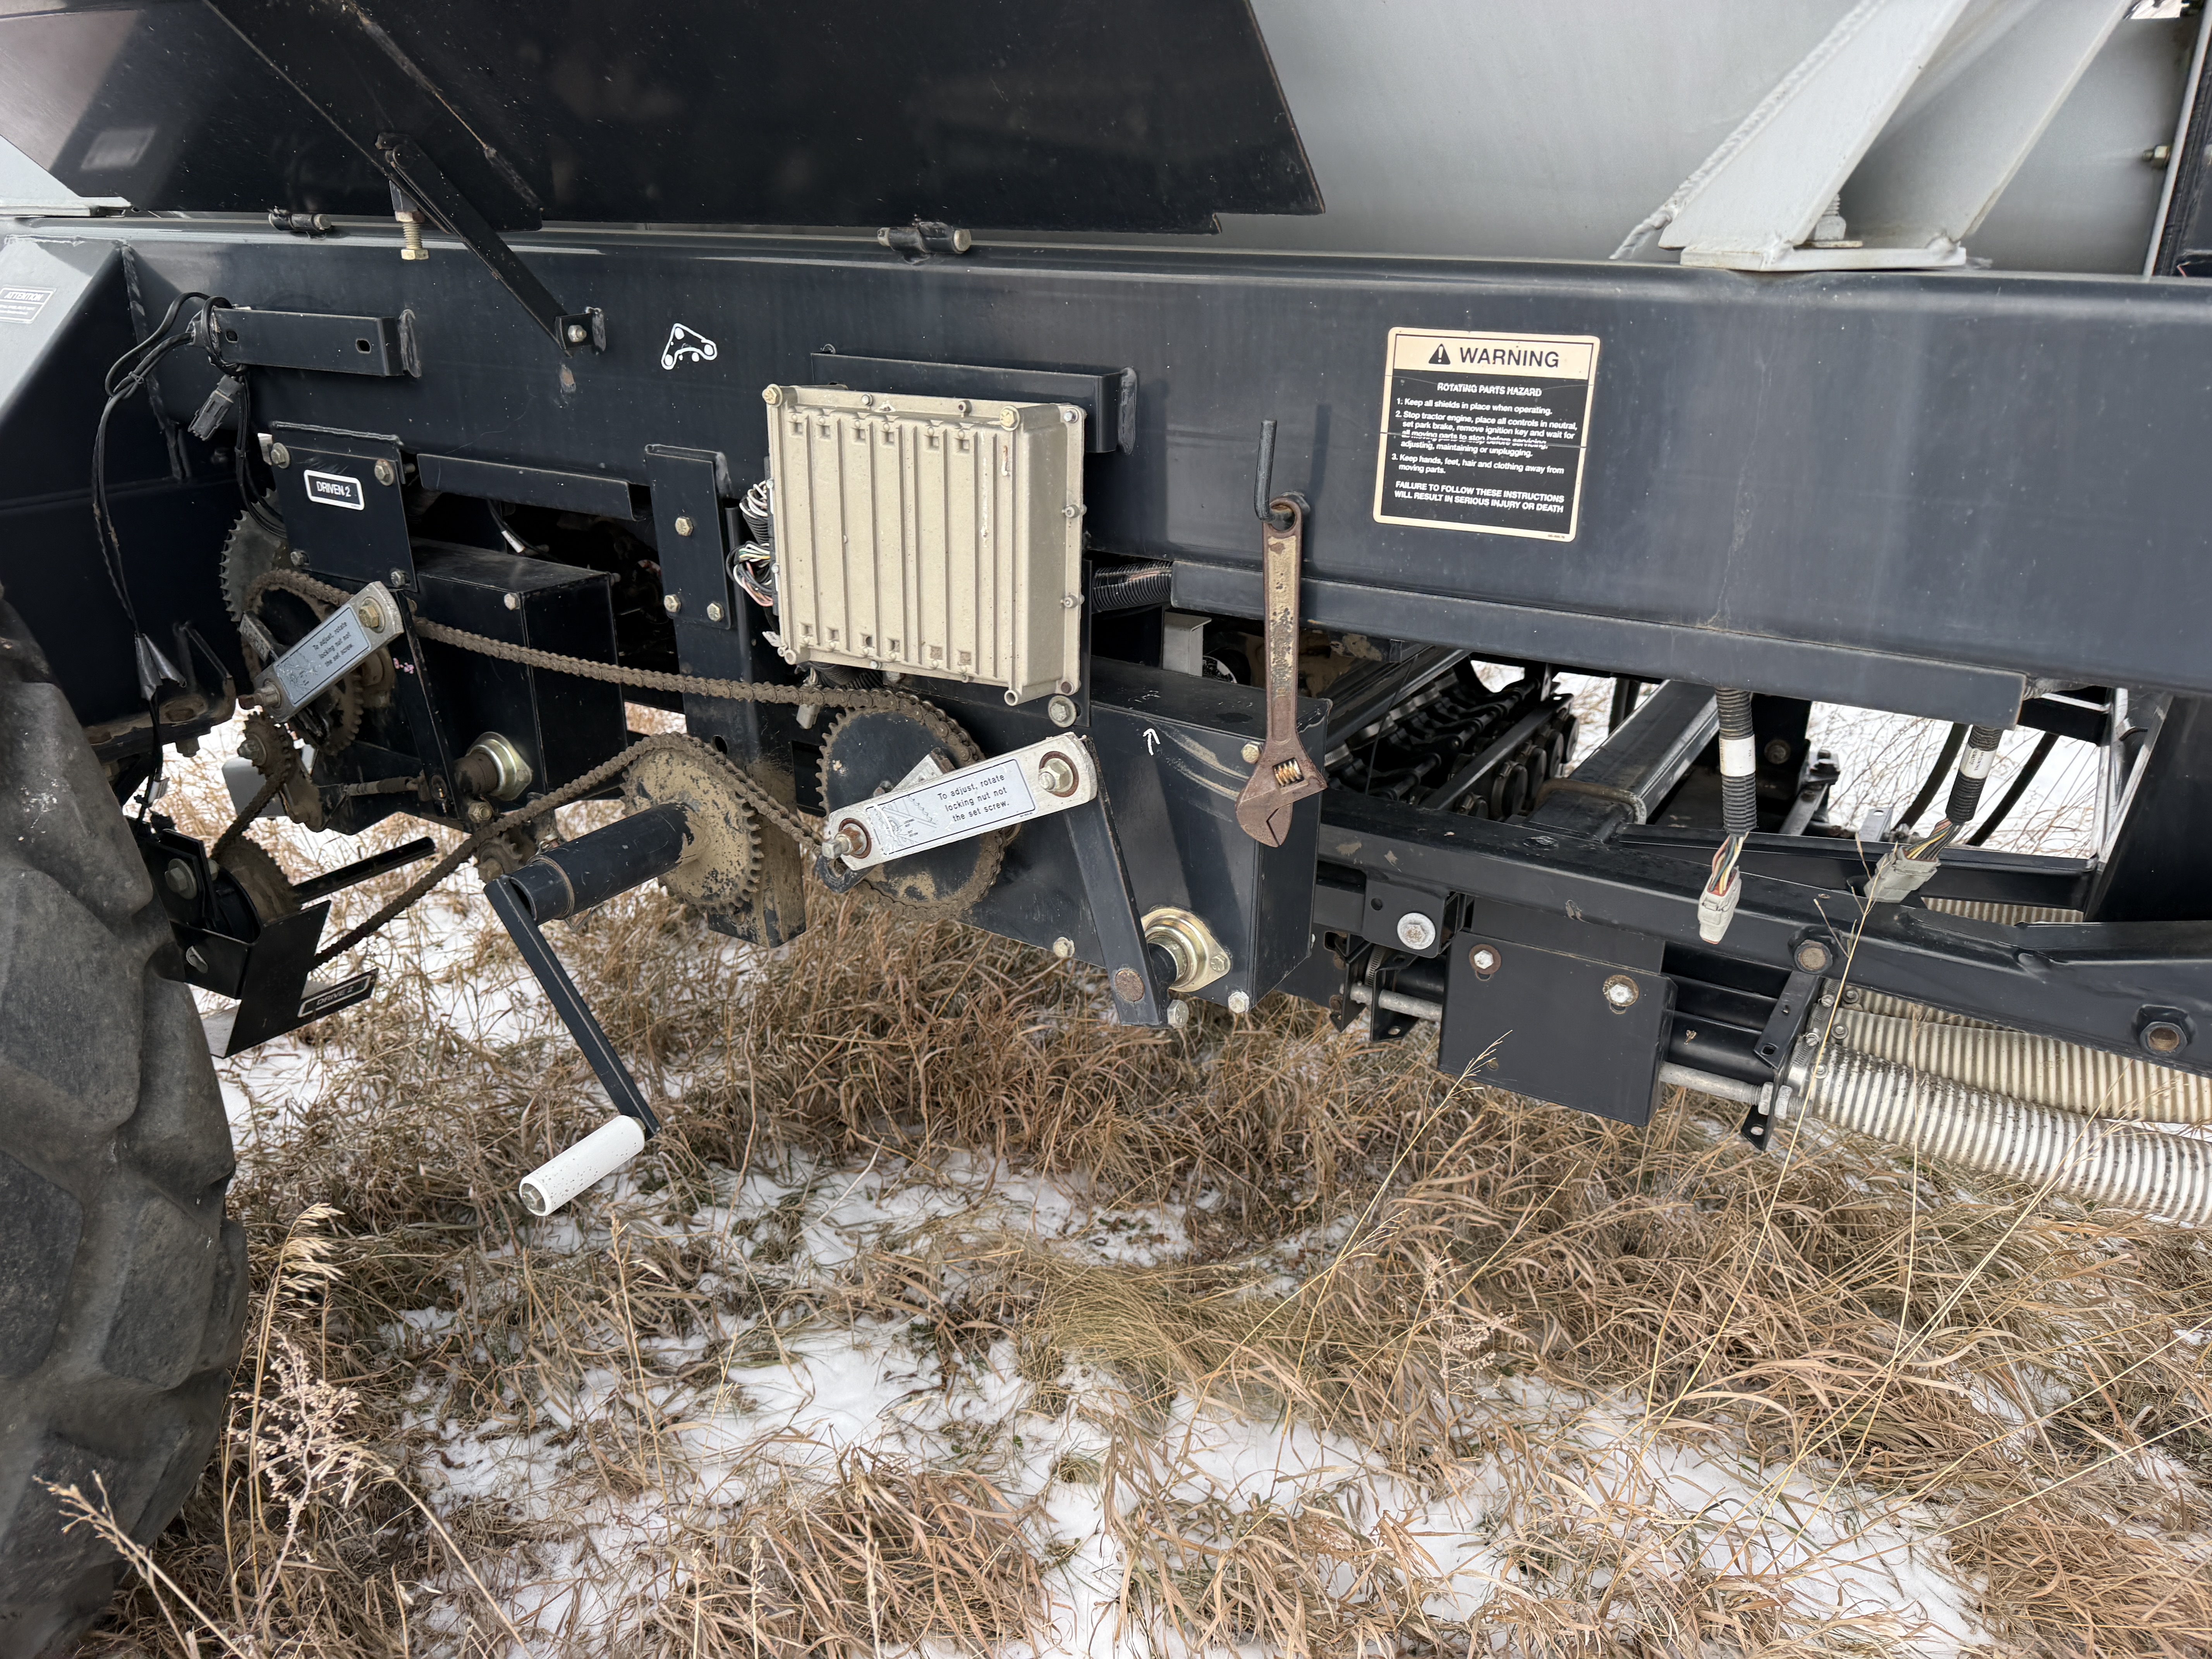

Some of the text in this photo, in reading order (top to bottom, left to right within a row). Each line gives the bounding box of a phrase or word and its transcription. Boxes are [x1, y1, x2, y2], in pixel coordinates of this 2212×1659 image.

[4, 292, 44, 301] ATTENTION
[1460, 347, 1559, 368] WARNING
[1437, 382, 1542, 397] ROTATING PARTS HAZARD
[1405, 398, 1423, 407] Keep
[1434, 400, 1460, 409] shields
[1470, 403, 1491, 411] place
[1514, 407, 1553, 416] operating.
[1403, 411, 1420, 420] Stop
[1447, 415, 1474, 423] engine,
[1475, 416, 1496, 424] place
[1508, 419, 1539, 427] controls
[1549, 422, 1578, 431] neutral,
[1432, 422, 1455, 431] brake,
[1485, 426, 1513, 434] ignition
[1515, 428, 1528, 437] key
[1400, 440, 1435, 450] adjusting,
[1436, 443, 1479, 454] maintaining
[1489, 447, 1533, 458] unplugging.
[1401, 429, 1548, 450] all moving parts to stop before servicing,
[1398, 464, 1424, 474] moving
[1399, 454, 1418, 463] Keep
[1419, 455, 1443, 465] hands,
[1444, 457, 1460, 466] feet,
[1462, 459, 1477, 467] hair
[1493, 462, 1523, 472] clothing
[1525, 465, 1546, 474] away
[1547, 466, 1565, 474] from
[316, 481, 351, 497] DRIVEN 2
[1395, 481, 1427, 490] FAILURE
[1441, 485, 1475, 495] FOLLOW
[1475, 488, 1502, 497] THESE
[1503, 490, 1565, 503] INSTRUCTIONS
[1394, 490, 1413, 499] WILL
[1413, 492, 1444, 501] RESULT
[1454, 496, 1489, 506] SERIOUS
[1491, 499, 1521, 508] INJURY
[1522, 502, 1535, 510] OR
[1536, 503, 1564, 513] DEATH
[950, 783, 978, 797] adjust,
[980, 774, 1005, 787] rotate
[945, 787, 1007, 812] locking nut not
[952, 799, 1010, 822] the set screw.
[316, 989, 345, 1005] DRIVE
